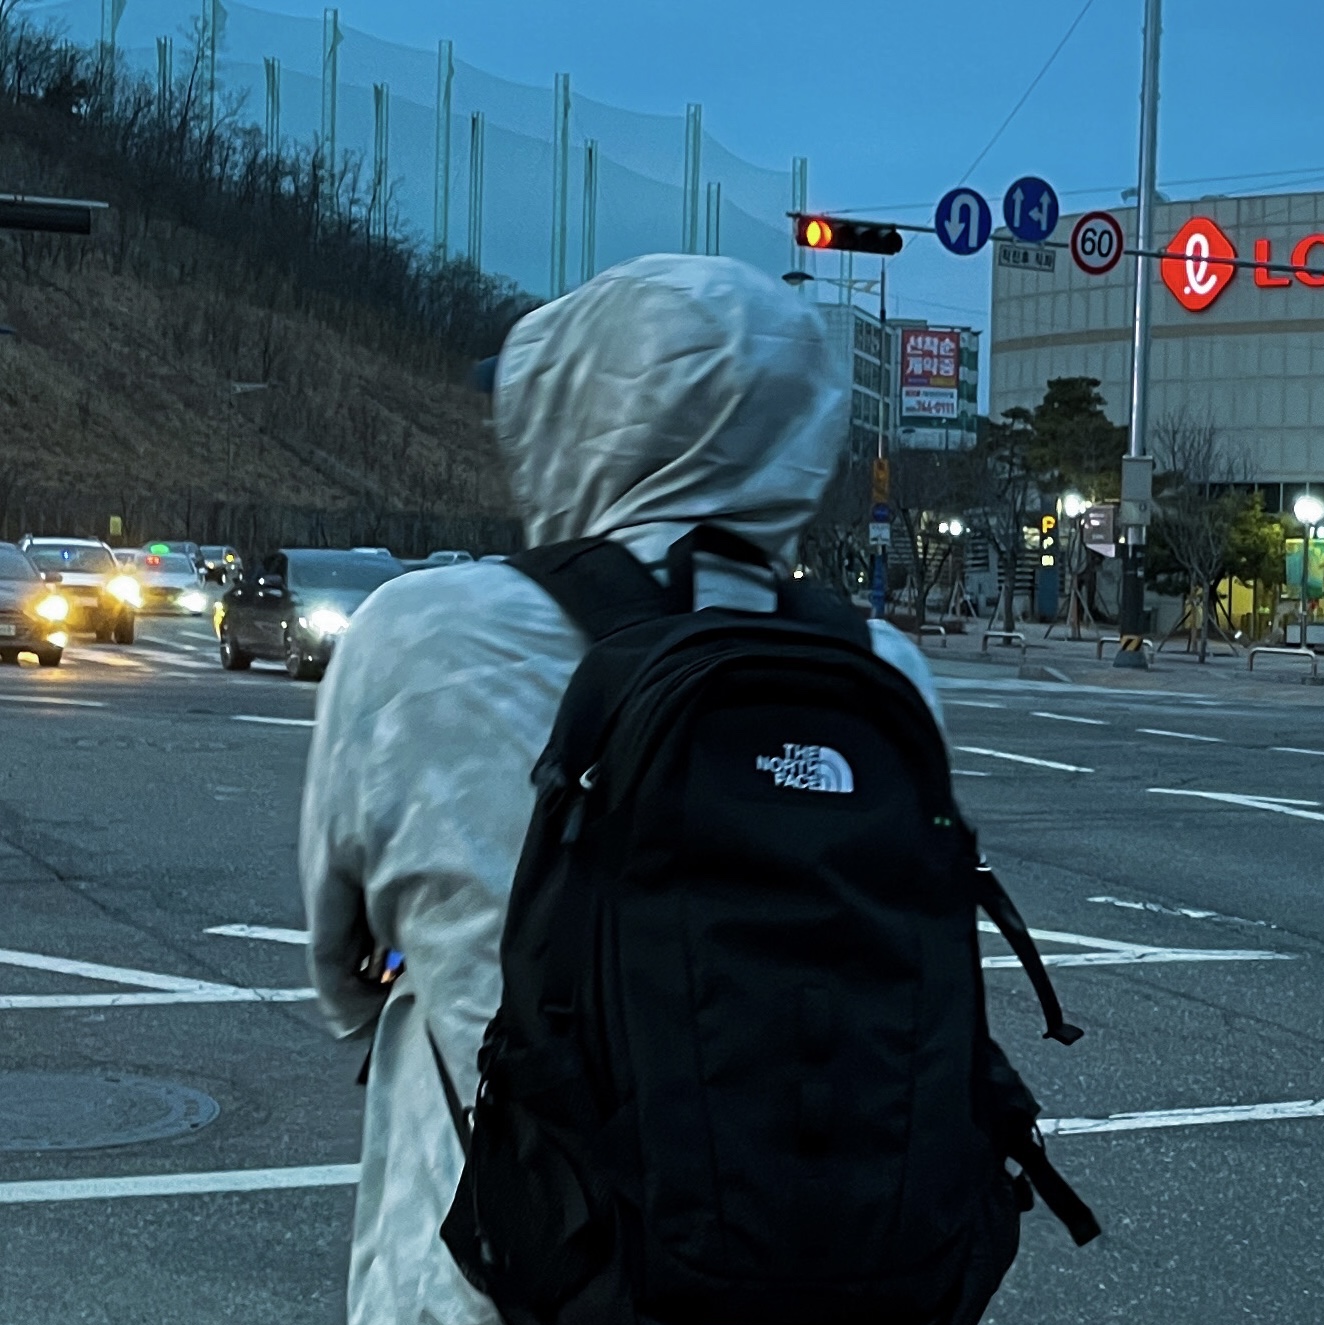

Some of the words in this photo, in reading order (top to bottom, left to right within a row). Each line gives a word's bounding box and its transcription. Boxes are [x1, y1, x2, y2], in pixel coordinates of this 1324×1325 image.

[1081, 227, 1113, 258] 60
[783, 743, 820, 761] THE
[756, 755, 819, 777] NORTH
[774, 772, 822, 790] FACE
